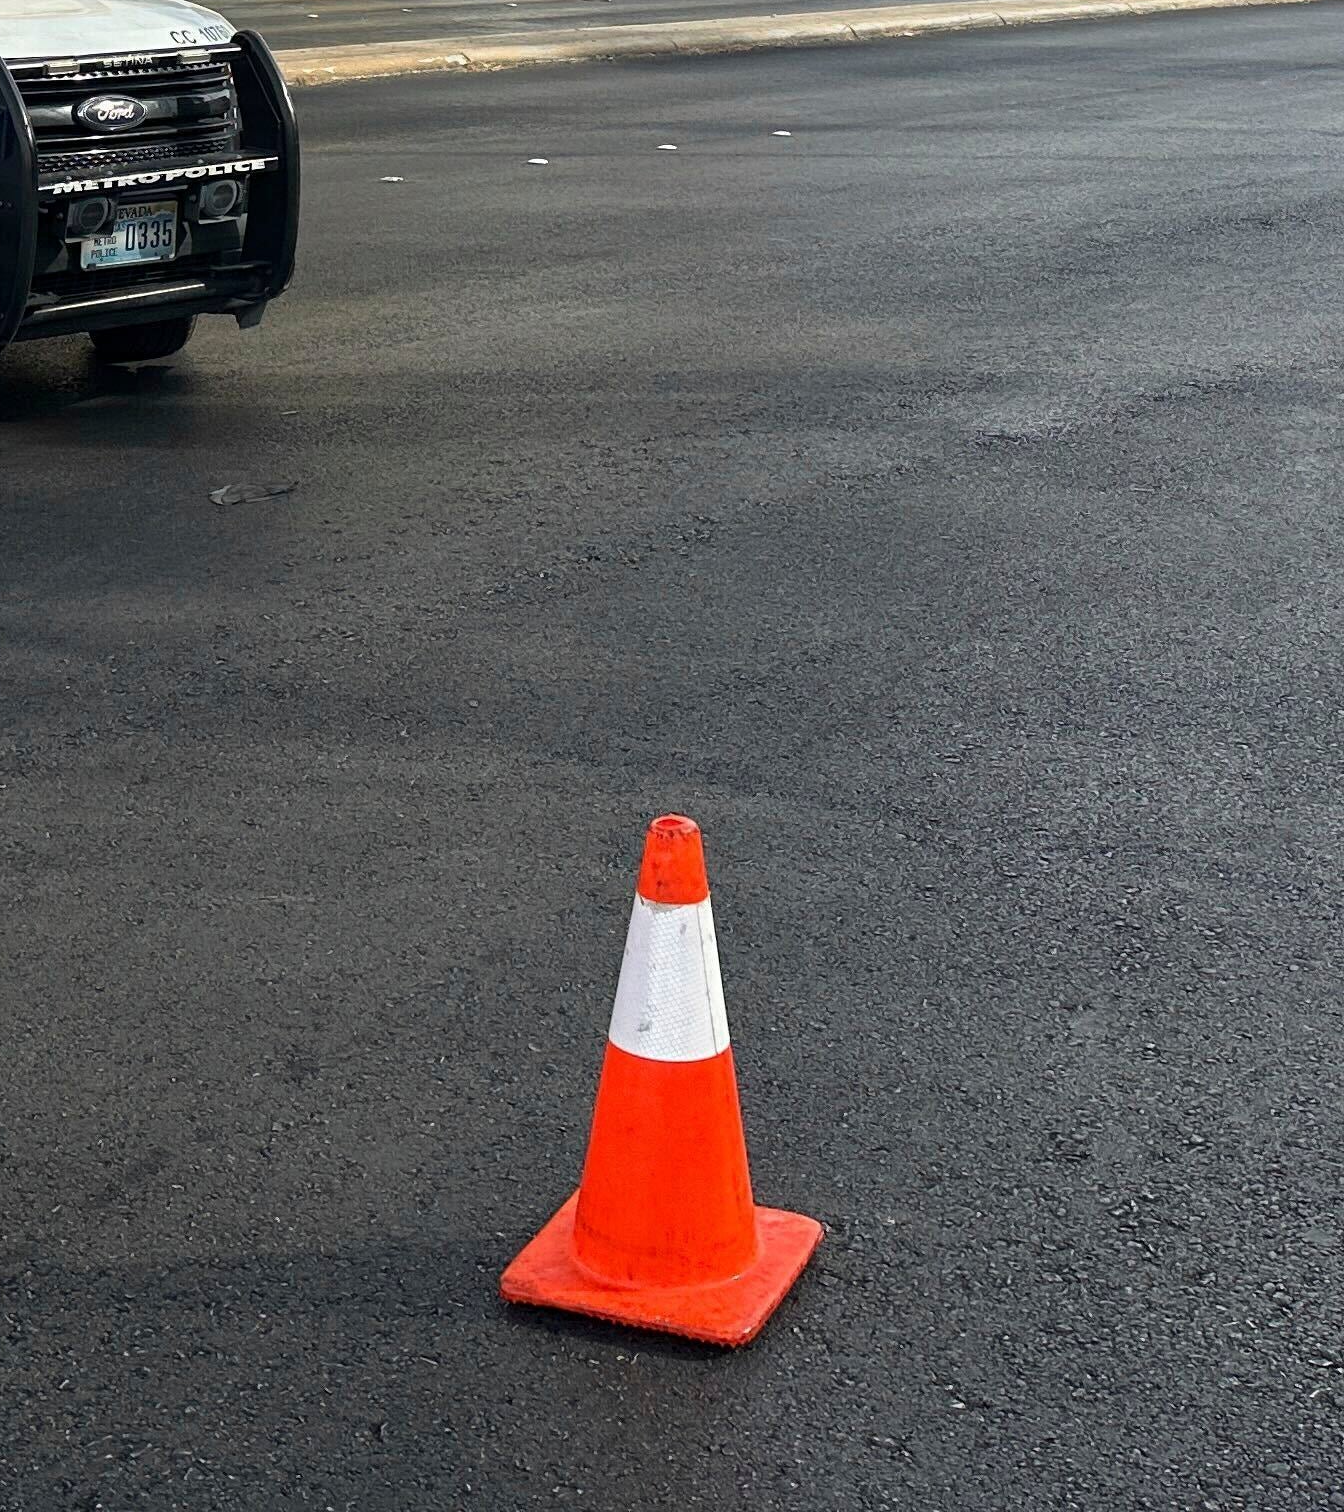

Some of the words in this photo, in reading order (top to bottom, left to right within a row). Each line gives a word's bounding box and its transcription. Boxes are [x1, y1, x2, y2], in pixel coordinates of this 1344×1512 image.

[170, 31, 196, 44] CC
[93, 100, 134, 122] Ford
[53, 173, 161, 194] METRO
[166, 160, 266, 181] POLICE
[117, 206, 154, 220] EVADA
[126, 219, 172, 251] 0335
[90, 247, 118, 258] POLICE
